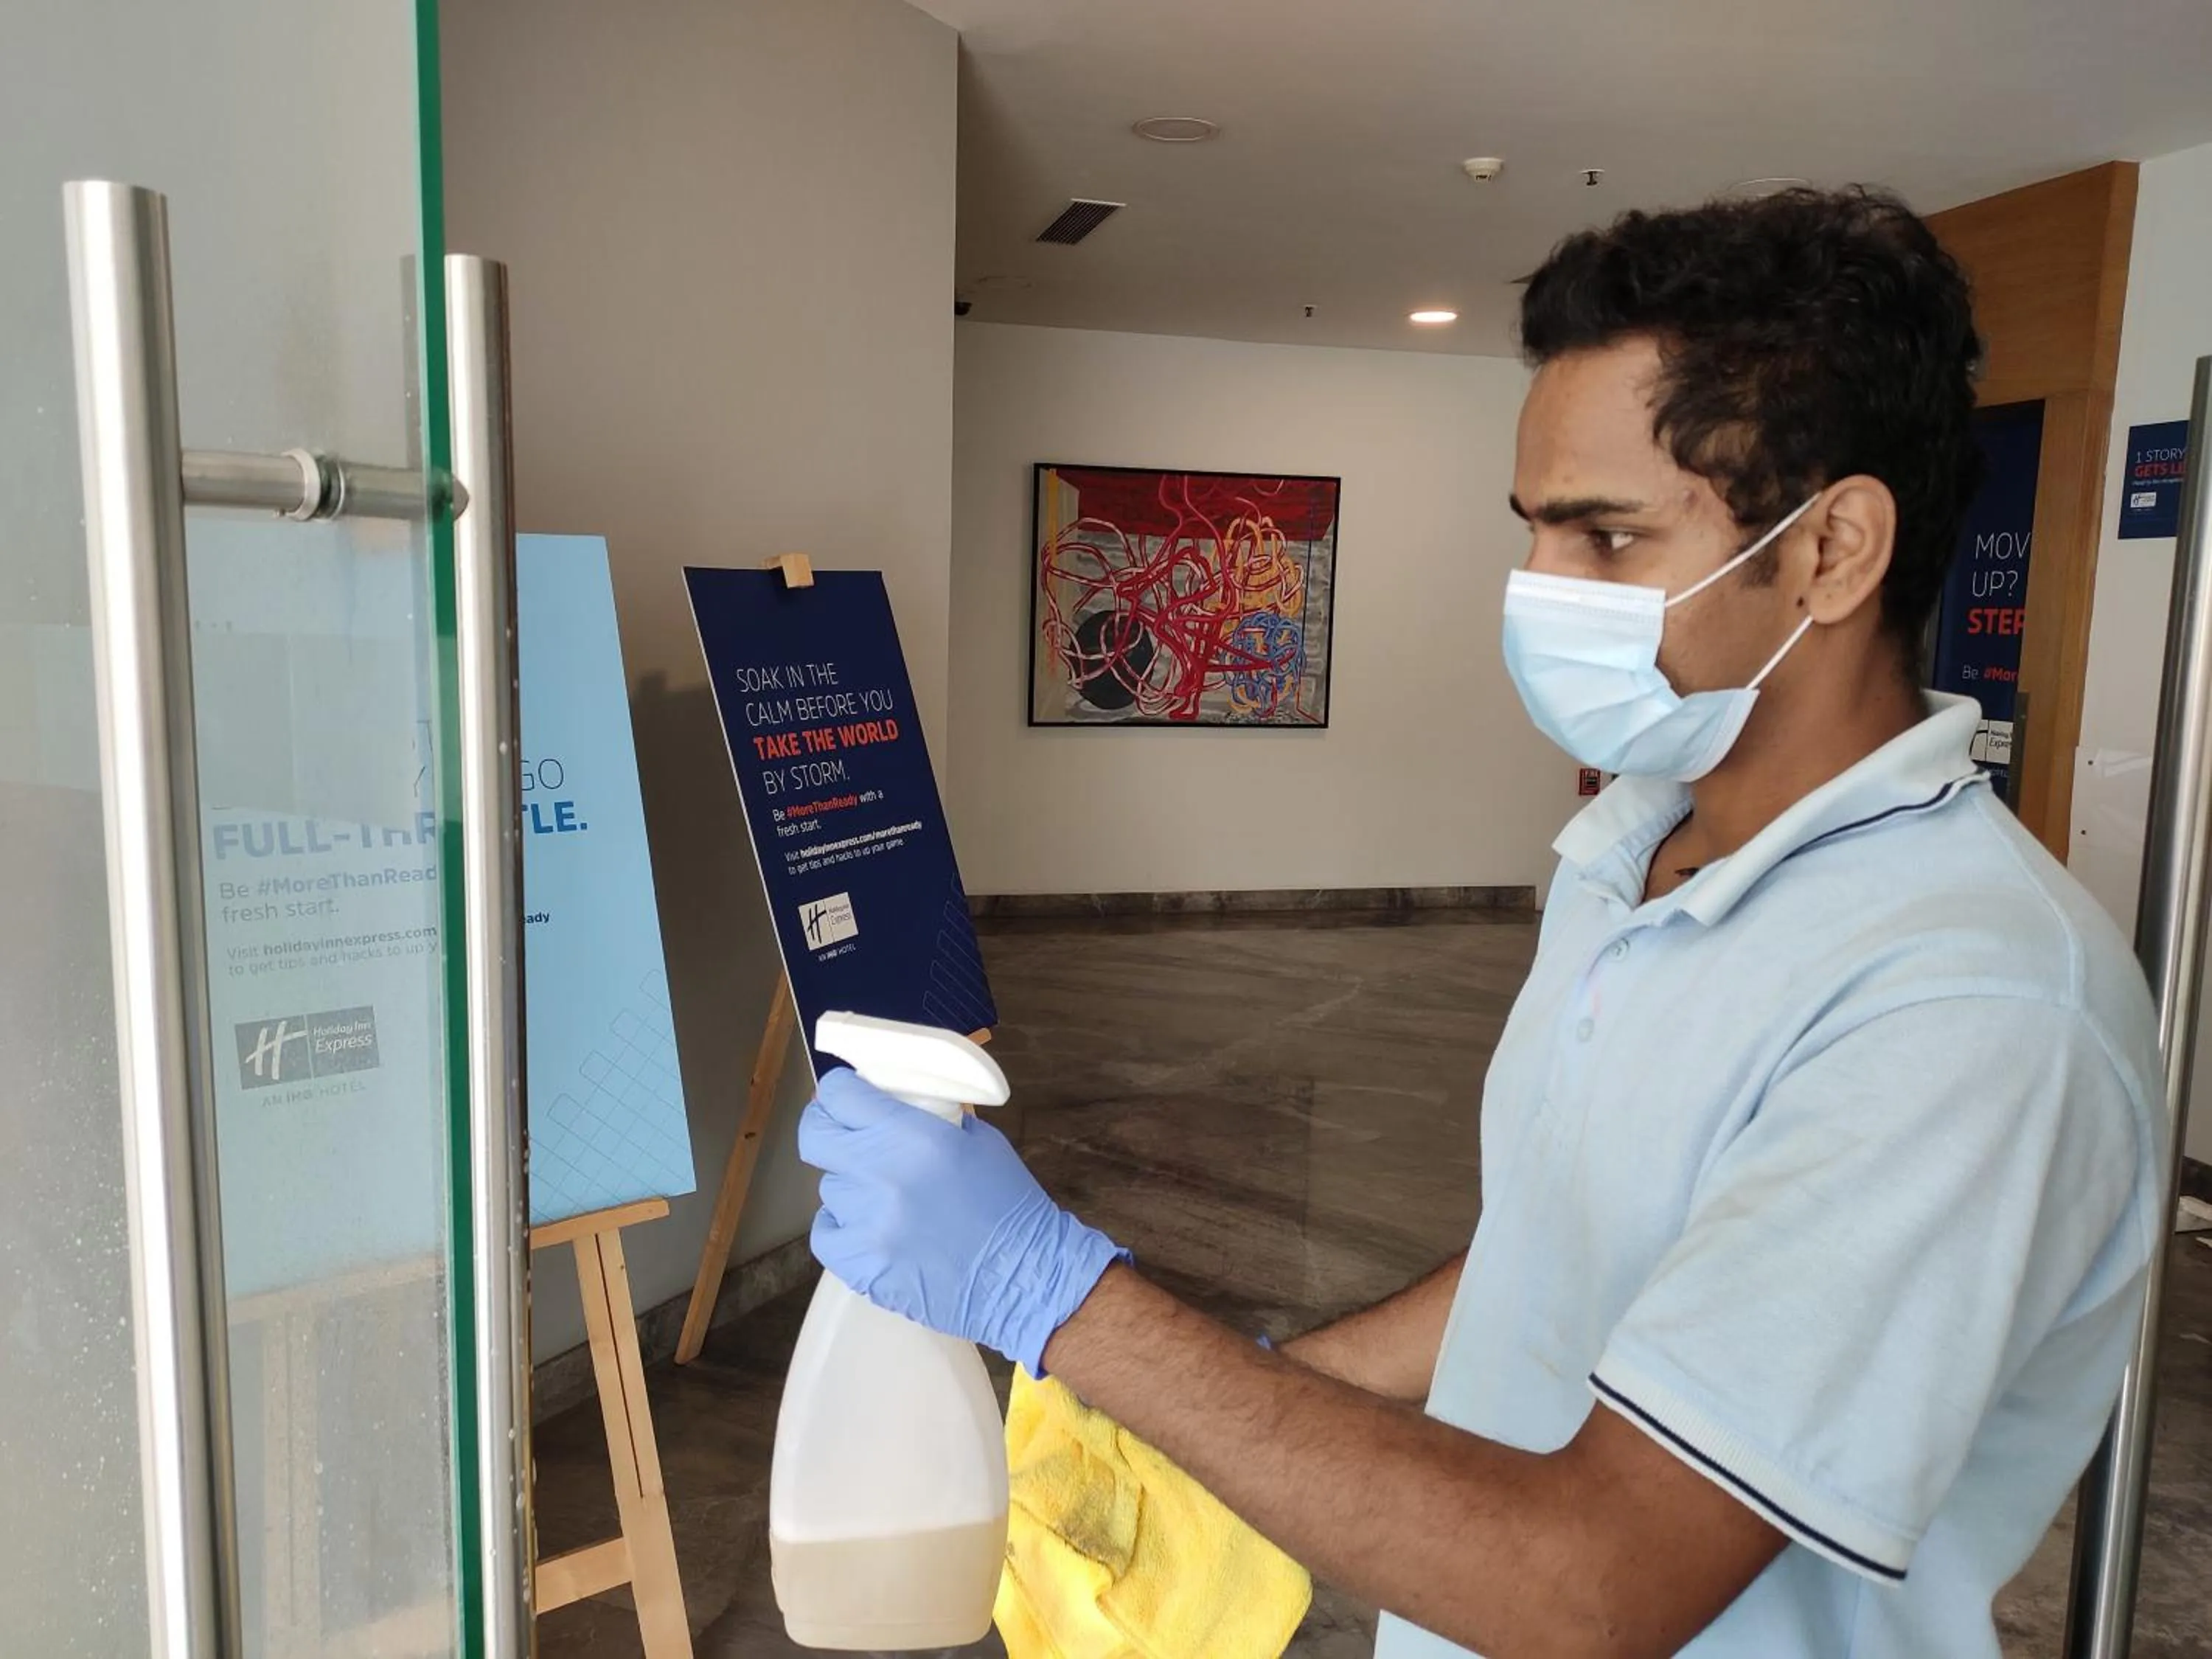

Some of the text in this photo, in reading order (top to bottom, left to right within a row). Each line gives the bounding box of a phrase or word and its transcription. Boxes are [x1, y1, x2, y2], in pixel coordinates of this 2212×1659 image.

[2146, 448, 2185, 462] STORY
[2135, 464, 2168, 477] GETS
[1975, 532, 2032, 560] MOV
[1972, 570, 2019, 597] UP?
[737, 663, 838, 692] SOAK IN THE
[1962, 665, 2019, 682] Be #Mor
[745, 689, 894, 726] CALM BEFORE YOU
[753, 720, 898, 761] TAKE THE WORLD
[762, 759, 850, 795] BY STORM.
[773, 790, 884, 822] Be #MoreThanReady with a
[776, 819, 822, 838] fresh start.
[785, 850, 800, 862] Visit
[788, 866, 796, 876] to
[797, 864, 809, 875] get
[809, 859, 822, 870] tips
[823, 855, 835, 866] and
[835, 850, 853, 863] hacks
[854, 848, 861, 858] to
[863, 846, 871, 856] up
[872, 842, 885, 855] your
[220, 882, 249, 900] Be
[222, 898, 340, 923] fresh start.
[226, 945, 260, 960] Visit
[228, 964, 245, 978] to
[248, 960, 274, 976] get
[278, 955, 305, 972] tips
[310, 951, 338, 967] and
[343, 946, 383, 962] hacks
[387, 945, 401, 956] to
[406, 942, 424, 957] up
[313, 1020, 371, 1037] Holiday Inn
[315, 1034, 372, 1054] Express
[262, 1081, 366, 1107] AN IHG HOTEL
